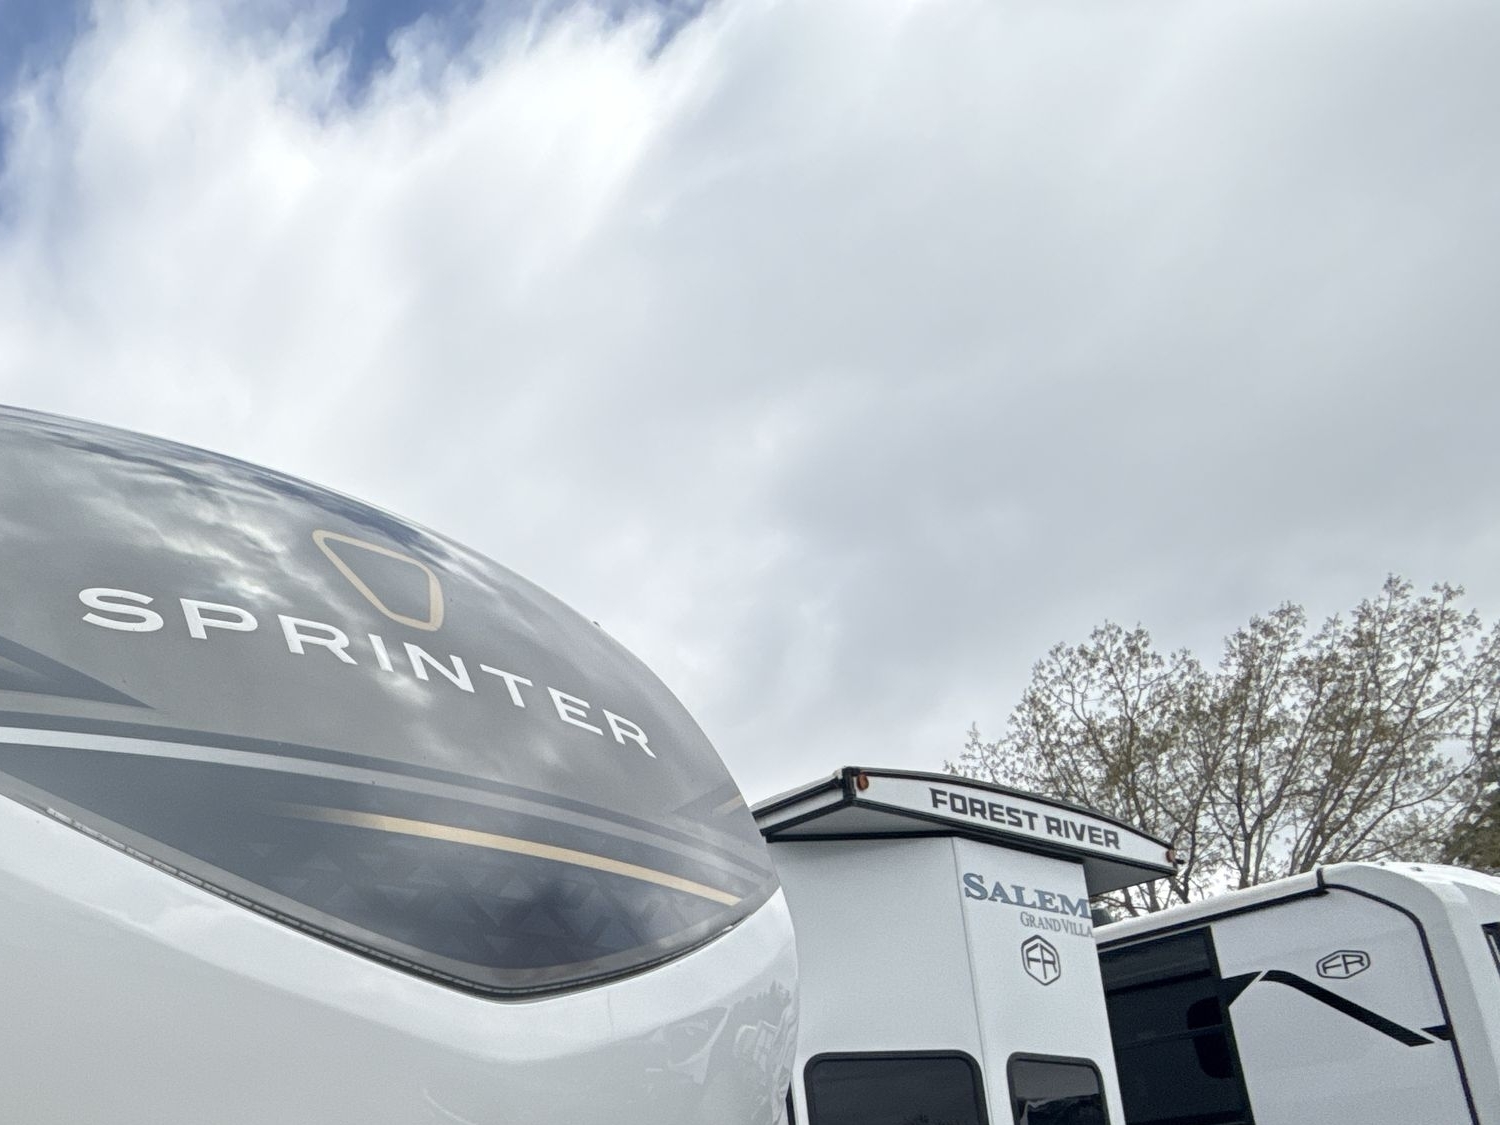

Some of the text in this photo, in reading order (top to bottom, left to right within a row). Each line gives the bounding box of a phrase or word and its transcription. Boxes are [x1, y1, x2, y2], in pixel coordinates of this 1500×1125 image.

[78, 587, 656, 758] SPRINTER
[929, 788, 1120, 849] FOREST RIVER
[963, 872, 1092, 919] SALEM
[1020, 911, 1061, 932] GRAND
